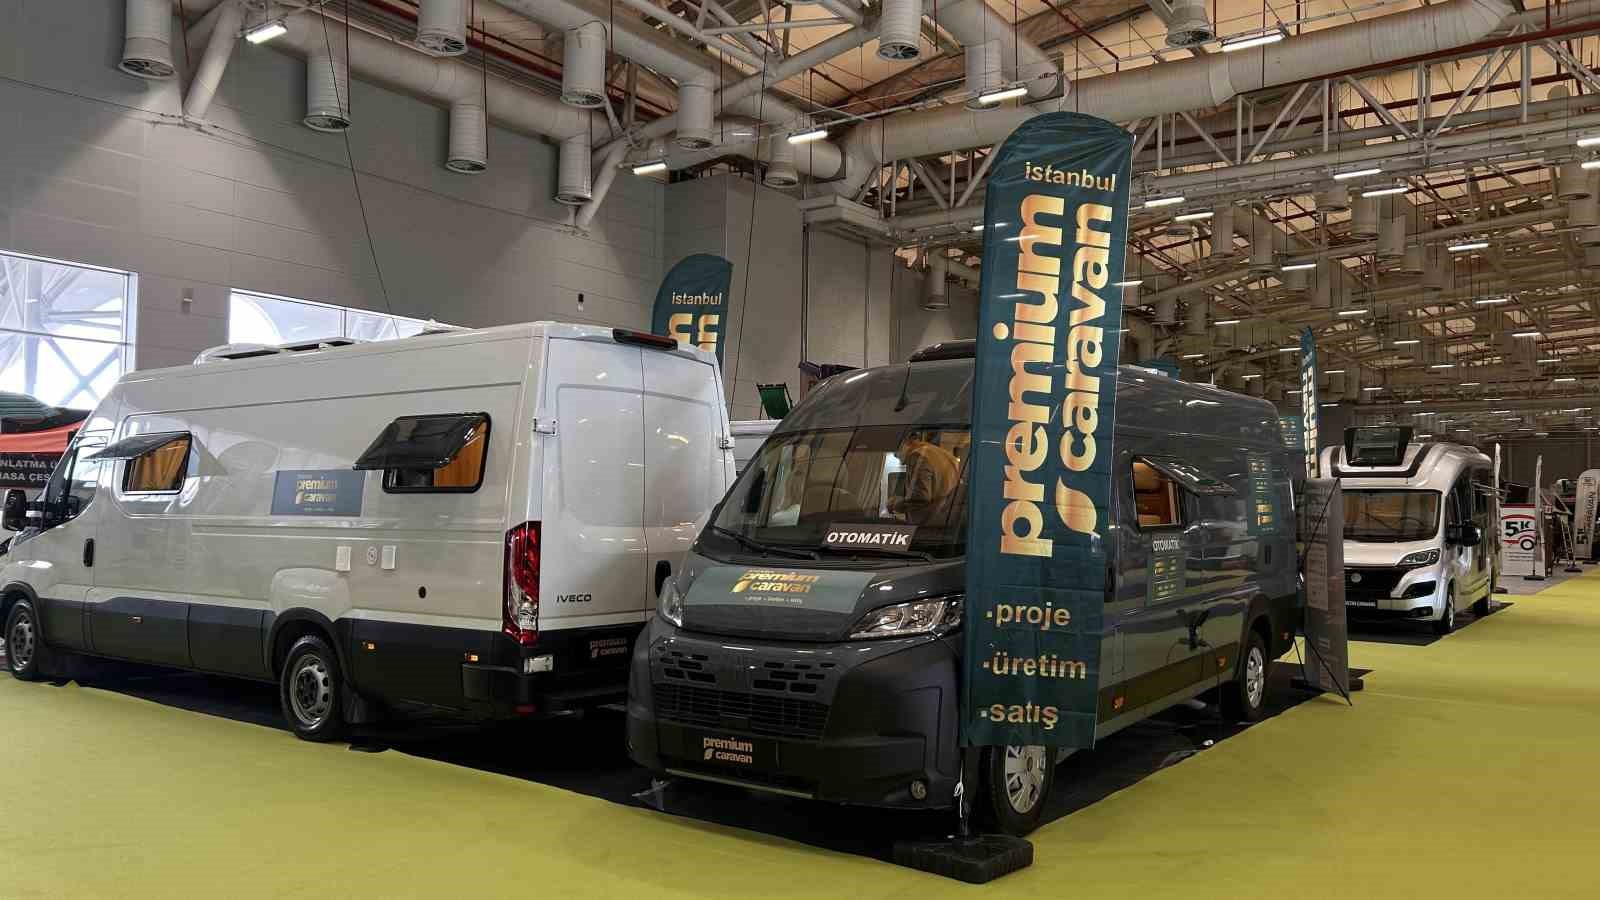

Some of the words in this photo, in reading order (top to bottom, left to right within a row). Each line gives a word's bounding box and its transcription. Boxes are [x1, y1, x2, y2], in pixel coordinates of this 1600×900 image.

[1024, 161, 1116, 192] istanbul
[671, 292, 722, 305] istanbul
[1060, 203, 1112, 472] caravan
[993, 194, 1065, 558] premium
[296, 479, 337, 492] premium
[827, 531, 910, 546] OTOMATİK
[738, 571, 819, 583] premium
[751, 581, 811, 593] caravan
[557, 594, 592, 603] IVECO
[995, 601, 1072, 630] proje
[992, 651, 1086, 679] üretim
[990, 701, 1059, 730] satış
[704, 737, 752, 752] premium
[716, 751, 752, 764] caravan
